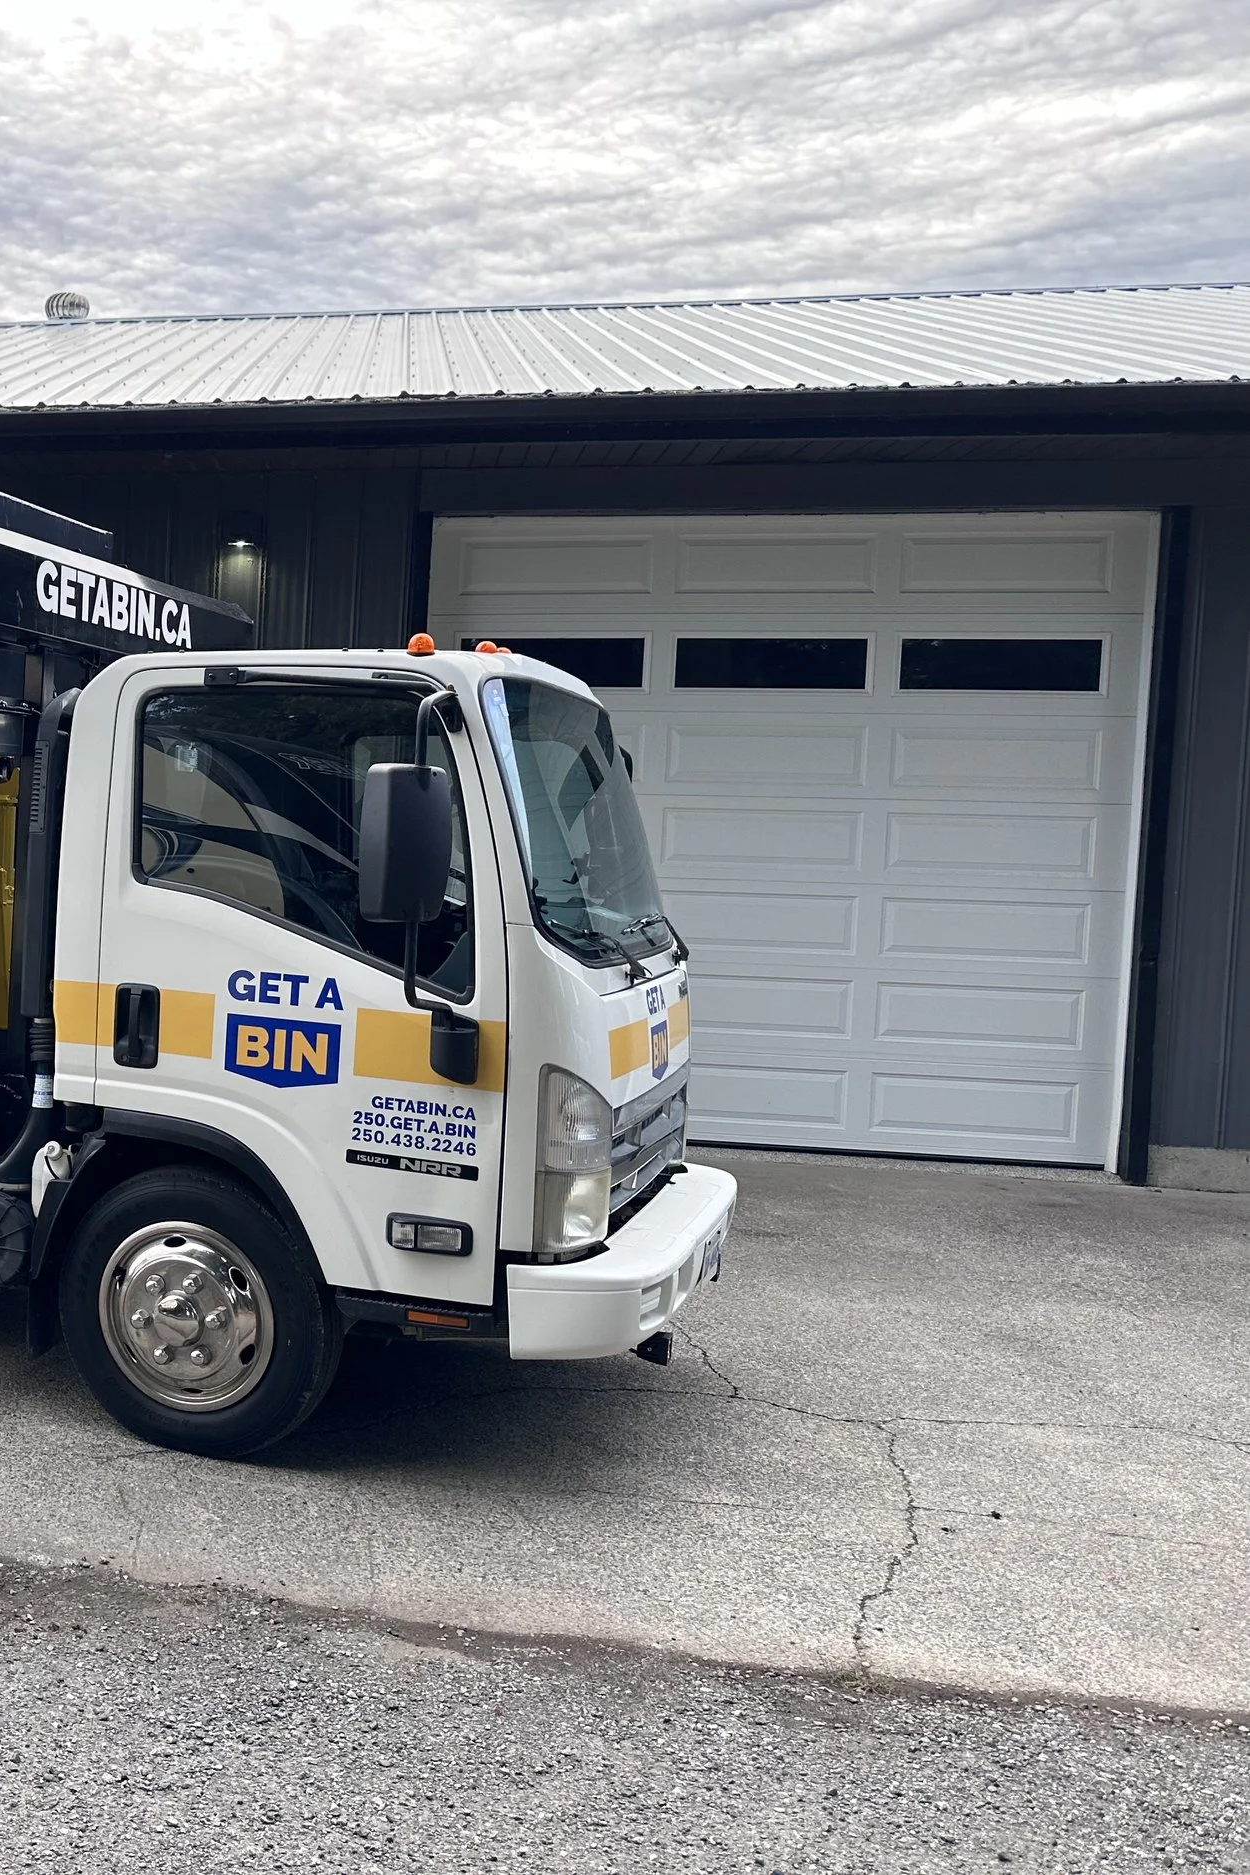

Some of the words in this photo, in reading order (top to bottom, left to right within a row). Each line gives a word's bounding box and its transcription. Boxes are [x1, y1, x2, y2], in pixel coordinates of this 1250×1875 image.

[36, 560, 192, 650] GETABIN.CA
[227, 969, 310, 1006] GET
[314, 977, 345, 1011] A
[646, 985, 660, 1016] GET
[659, 983, 667, 1011] A
[236, 1025, 328, 1075] BIN
[653, 1029, 667, 1070] BIN
[371, 1095, 477, 1121] GETABIN.CA
[352, 1110, 477, 1140] 250.GET.A.BIN
[351, 1127, 477, 1157] 250.438.2246
[356, 1153, 390, 1166] ISUZU
[399, 1158, 462, 1178] NRR
